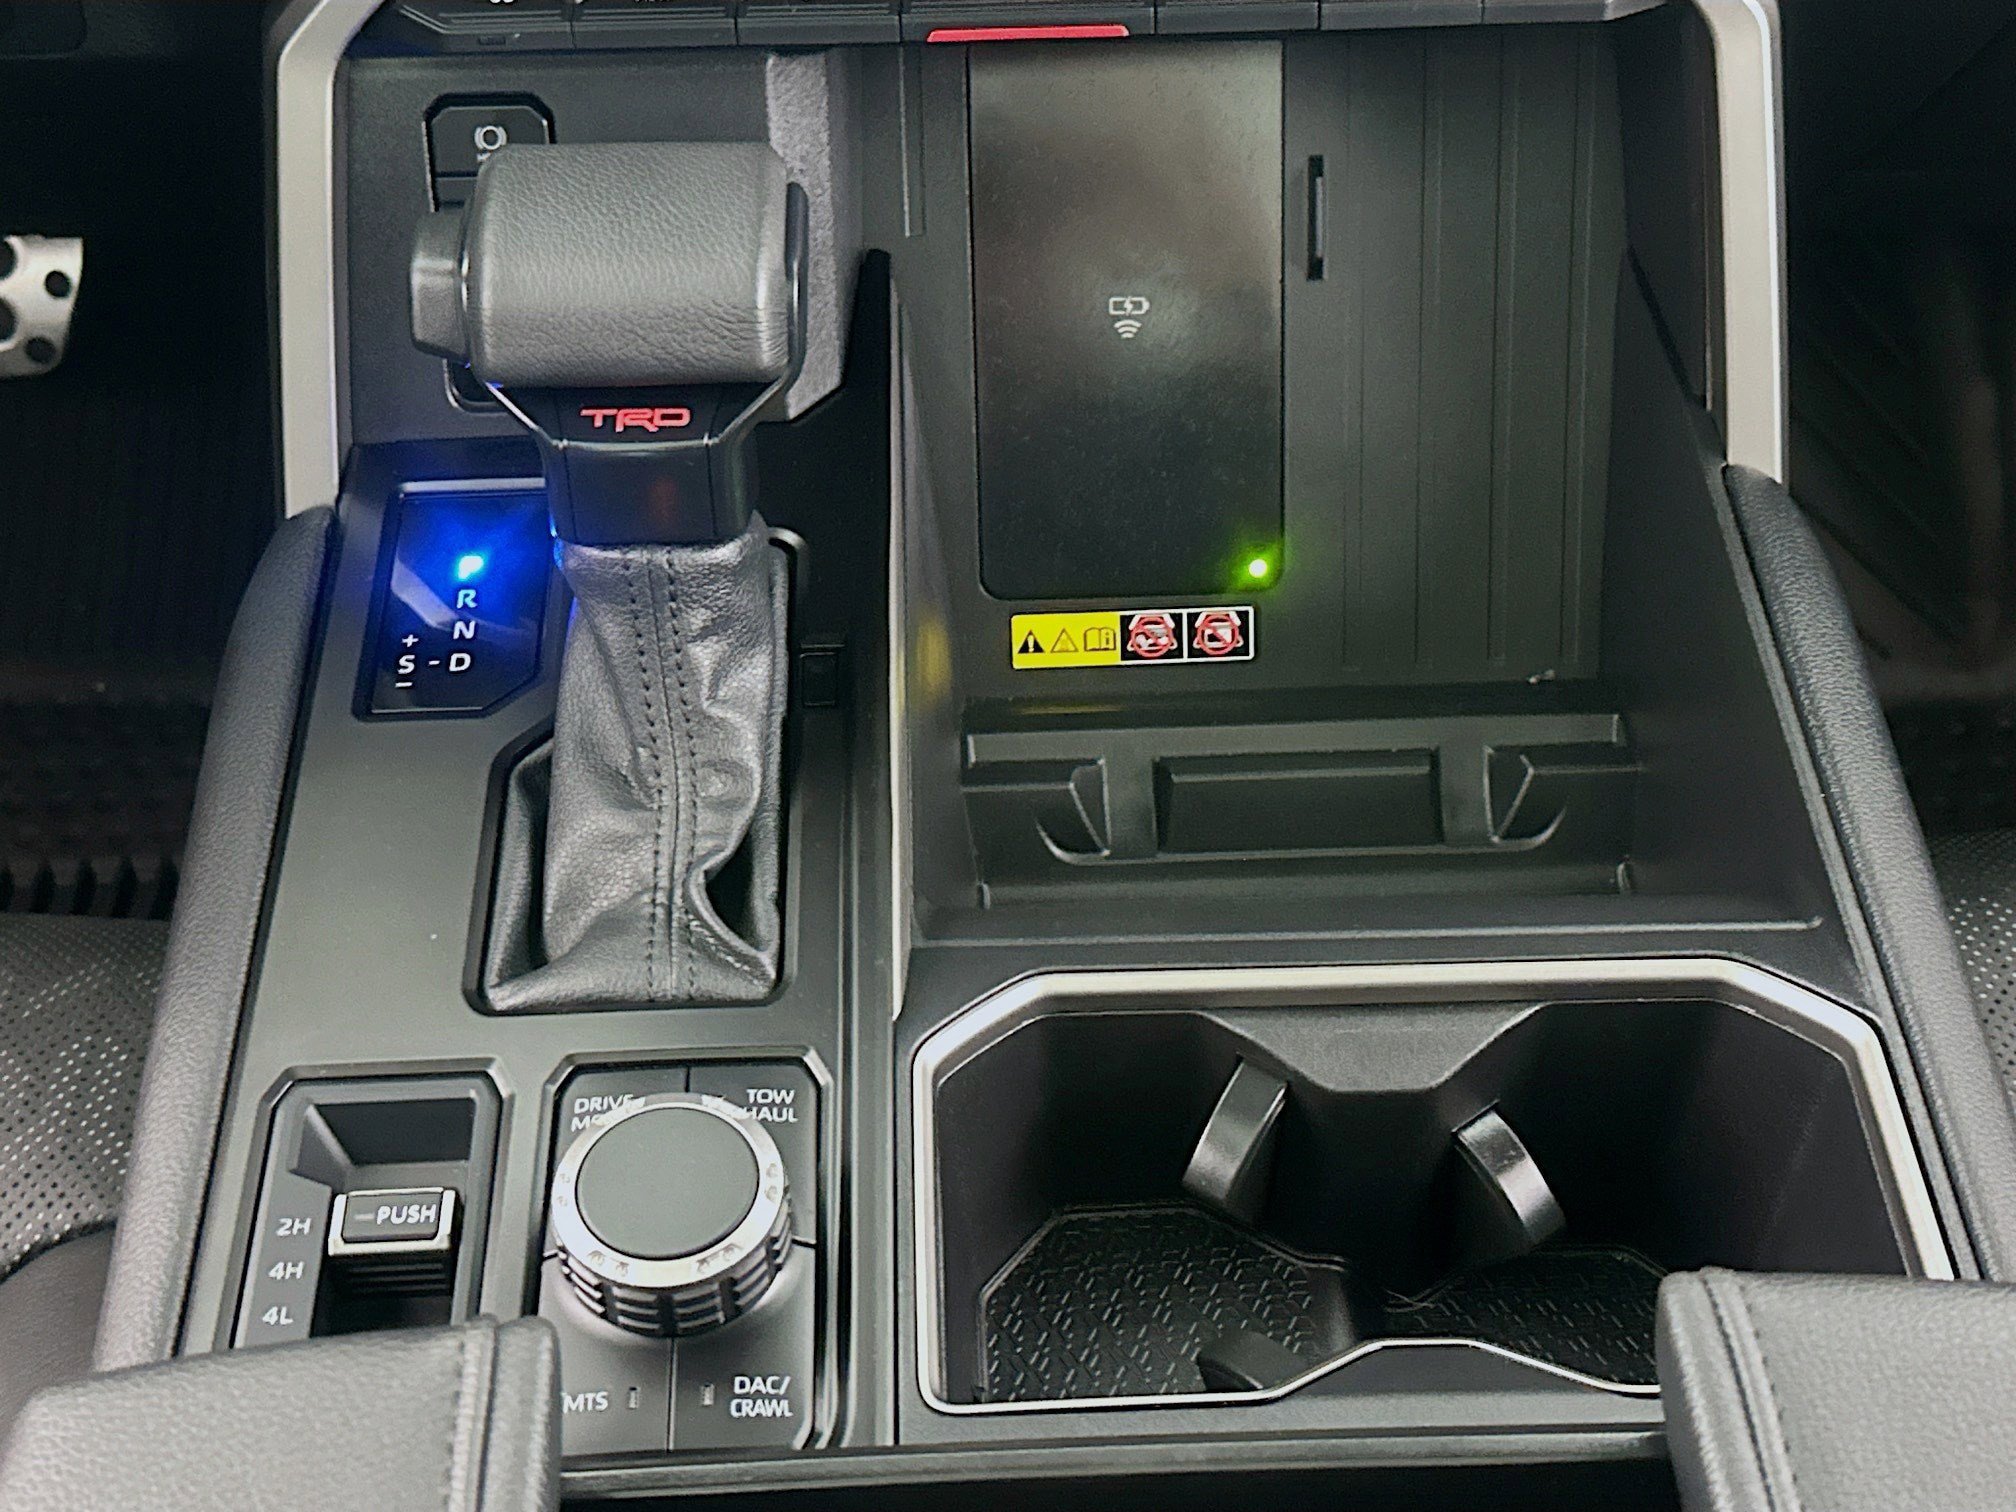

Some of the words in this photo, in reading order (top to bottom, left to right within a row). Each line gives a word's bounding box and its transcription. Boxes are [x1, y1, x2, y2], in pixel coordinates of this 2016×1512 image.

[580, 407, 691, 432] TRD
[456, 588, 478, 609] R
[453, 620, 476, 640] N
[398, 654, 416, 674] S
[449, 652, 471, 672] D
[746, 1088, 795, 1104] TOW
[376, 1204, 437, 1225] PUSH
[276, 1217, 312, 1237] 2H
[268, 1261, 304, 1280] 4H
[262, 1306, 294, 1325] 4L
[734, 1376, 791, 1395] DAC/
[561, 1391, 608, 1413] MTS
[730, 1398, 793, 1418] CRAWL
